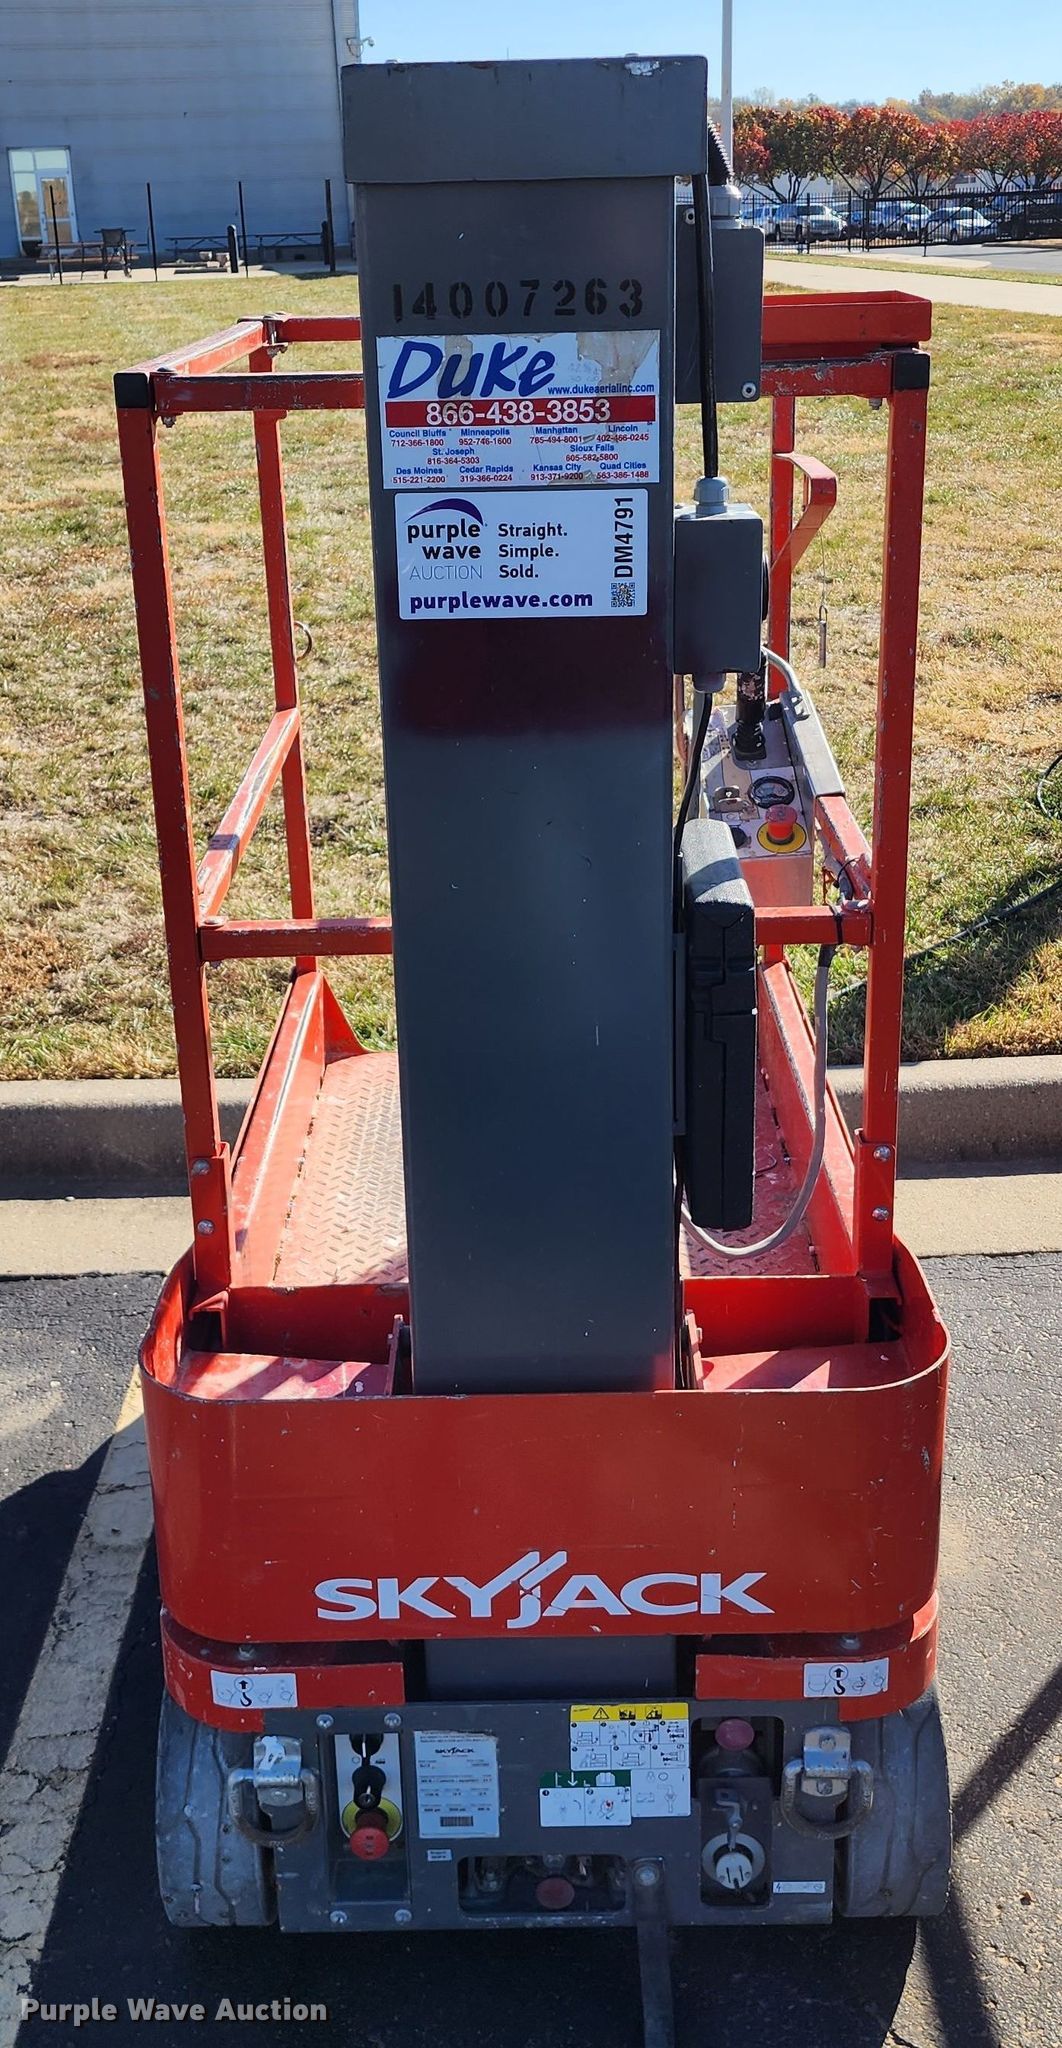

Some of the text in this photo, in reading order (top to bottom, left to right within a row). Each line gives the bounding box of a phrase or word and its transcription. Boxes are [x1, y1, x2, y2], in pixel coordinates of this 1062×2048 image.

[393, 278, 643, 323] 14007263
[547, 382, 655, 395] www.dukeaerialinc.com
[426, 398, 611, 426] 866-438-3853
[389, 428, 447, 438] Council Bluffs
[460, 427, 510, 438] Minneapolis
[535, 426, 578, 434] Manhattan
[608, 424, 638, 433] Lincoln
[432, 446, 475, 456] St. Joseph
[569, 443, 615, 453] Sioux Falls
[395, 466, 443, 475] Des Moines
[485, 465, 513, 474] Rapids
[565, 463, 581, 473] City
[599, 461, 647, 470] Quad Cities
[392, 475, 446, 484] 515-221-2200
[530, 472, 584, 481] 913-371-9200
[407, 518, 481, 543] purple
[498, 522, 568, 540] Straight.
[614, 497, 634, 578] DM4791
[422, 544, 482, 560] wave
[498, 544, 560, 561] Simple.
[409, 565, 483, 581] AUCTION
[499, 564, 539, 579] Sold.
[410, 591, 593, 614] purplewave.com
[313, 1549, 776, 1630] SKYJACK
